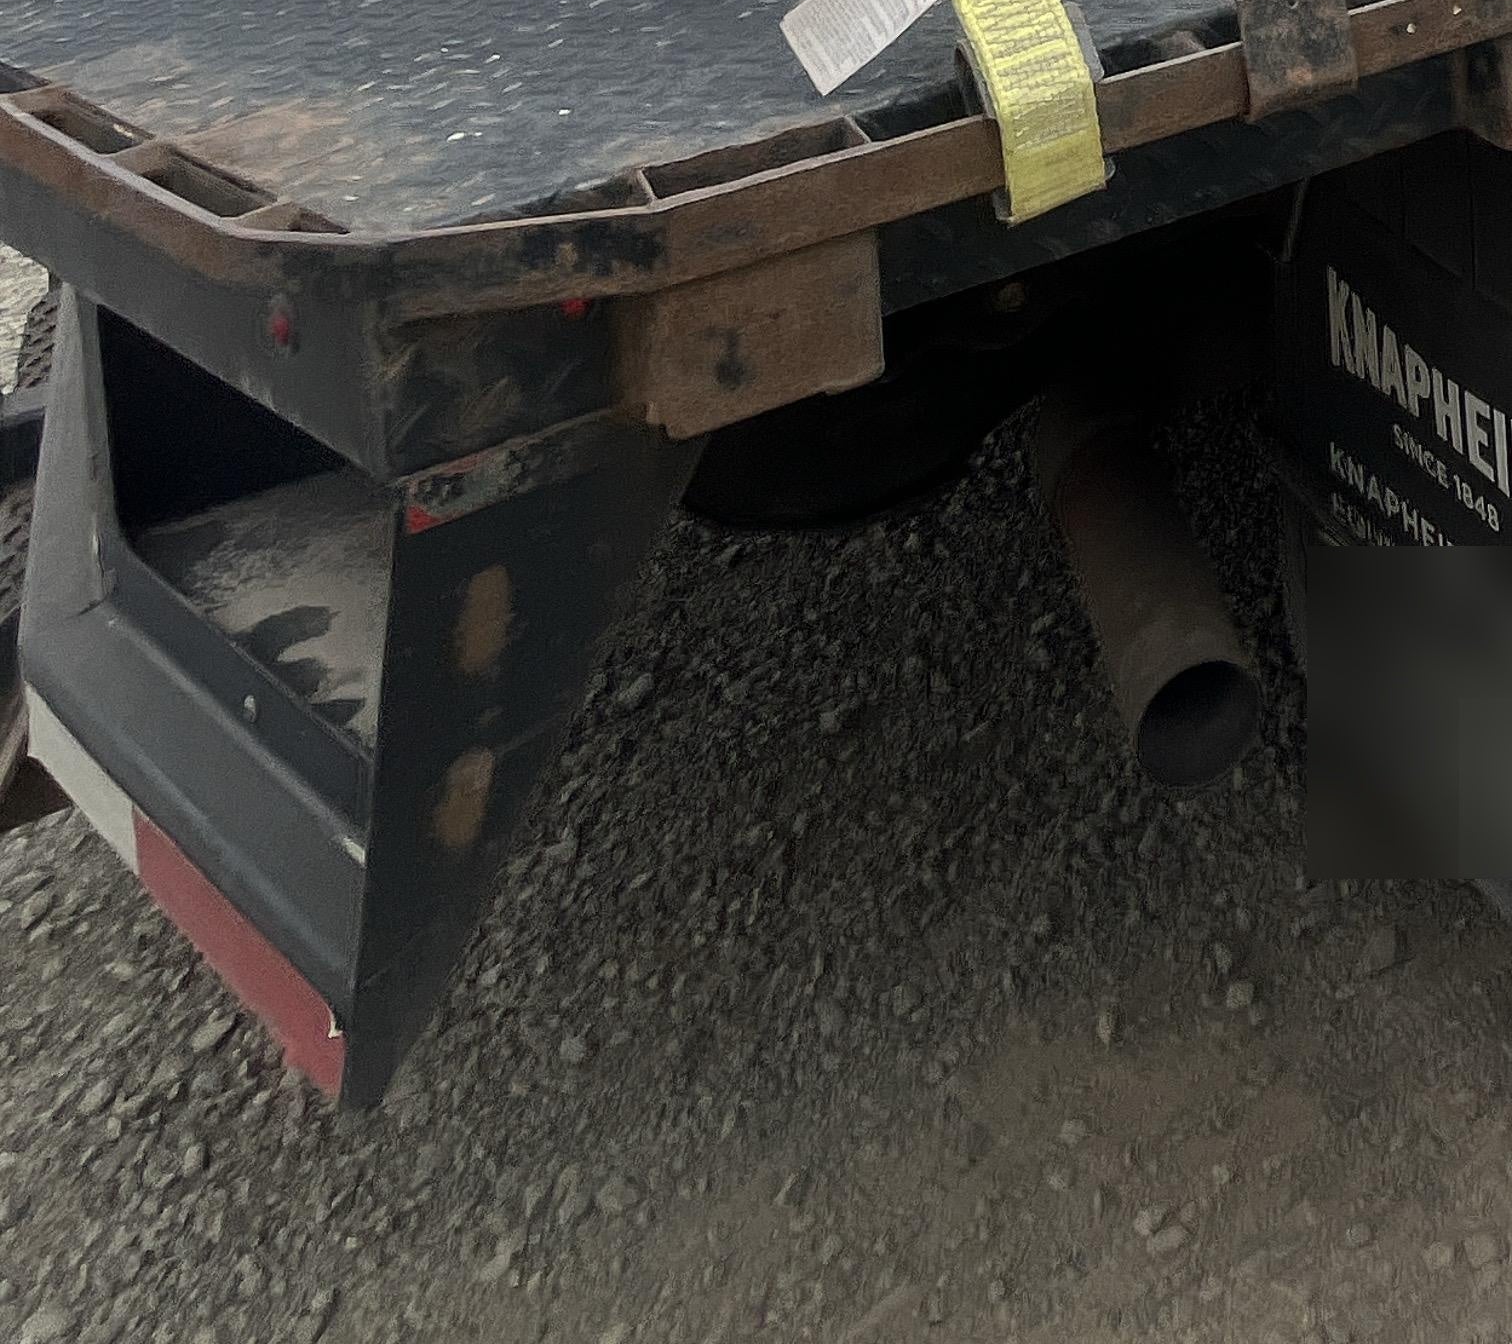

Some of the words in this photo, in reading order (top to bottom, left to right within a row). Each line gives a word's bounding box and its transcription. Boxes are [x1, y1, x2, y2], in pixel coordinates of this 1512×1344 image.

[1330, 441, 1455, 547] KNAPHE
[1393, 423, 1451, 490] SINCE
[1453, 473, 1500, 533] 1848
